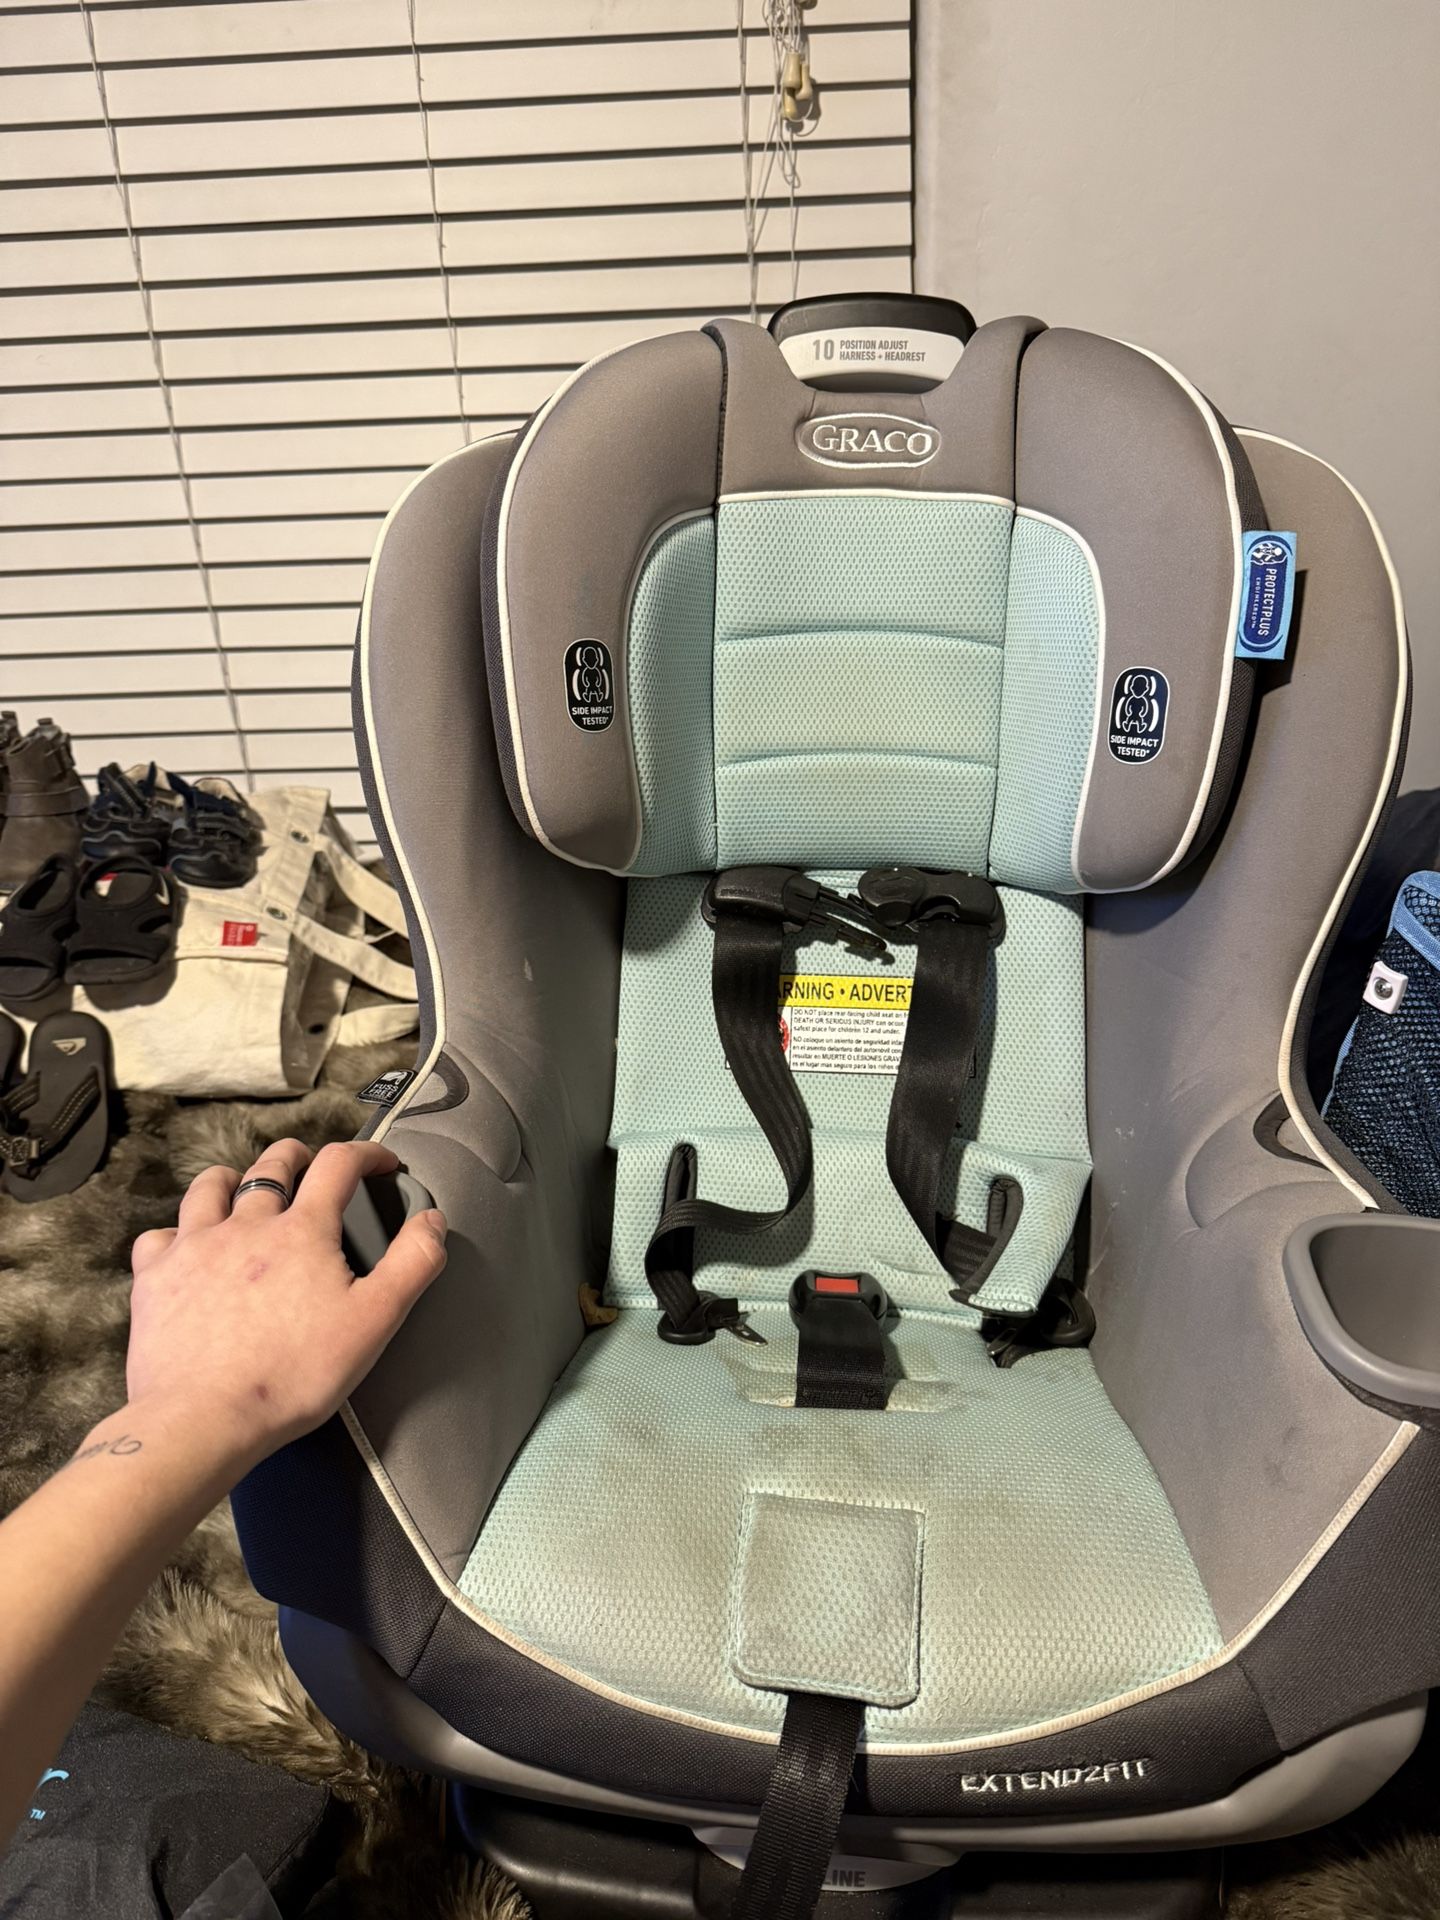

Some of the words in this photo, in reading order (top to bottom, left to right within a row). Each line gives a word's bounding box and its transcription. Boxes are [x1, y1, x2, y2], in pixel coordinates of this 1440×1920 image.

[812, 339, 834, 361] 10
[840, 340, 876, 350] POSITION
[878, 340, 908, 350] ADJUST
[839, 351, 876, 361] HARNESS
[884, 352, 926, 362] HEADREST
[812, 424, 932, 455] GRACO
[1258, 568, 1277, 636] PROTECTPLUS
[572, 706, 590, 715] SIDE
[590, 706, 612, 714] IMPACT
[1110, 735, 1126, 744] SIDE
[1127, 736, 1158, 747] IMPACT
[961, 1758, 1148, 1792] EXTEND2FIT
